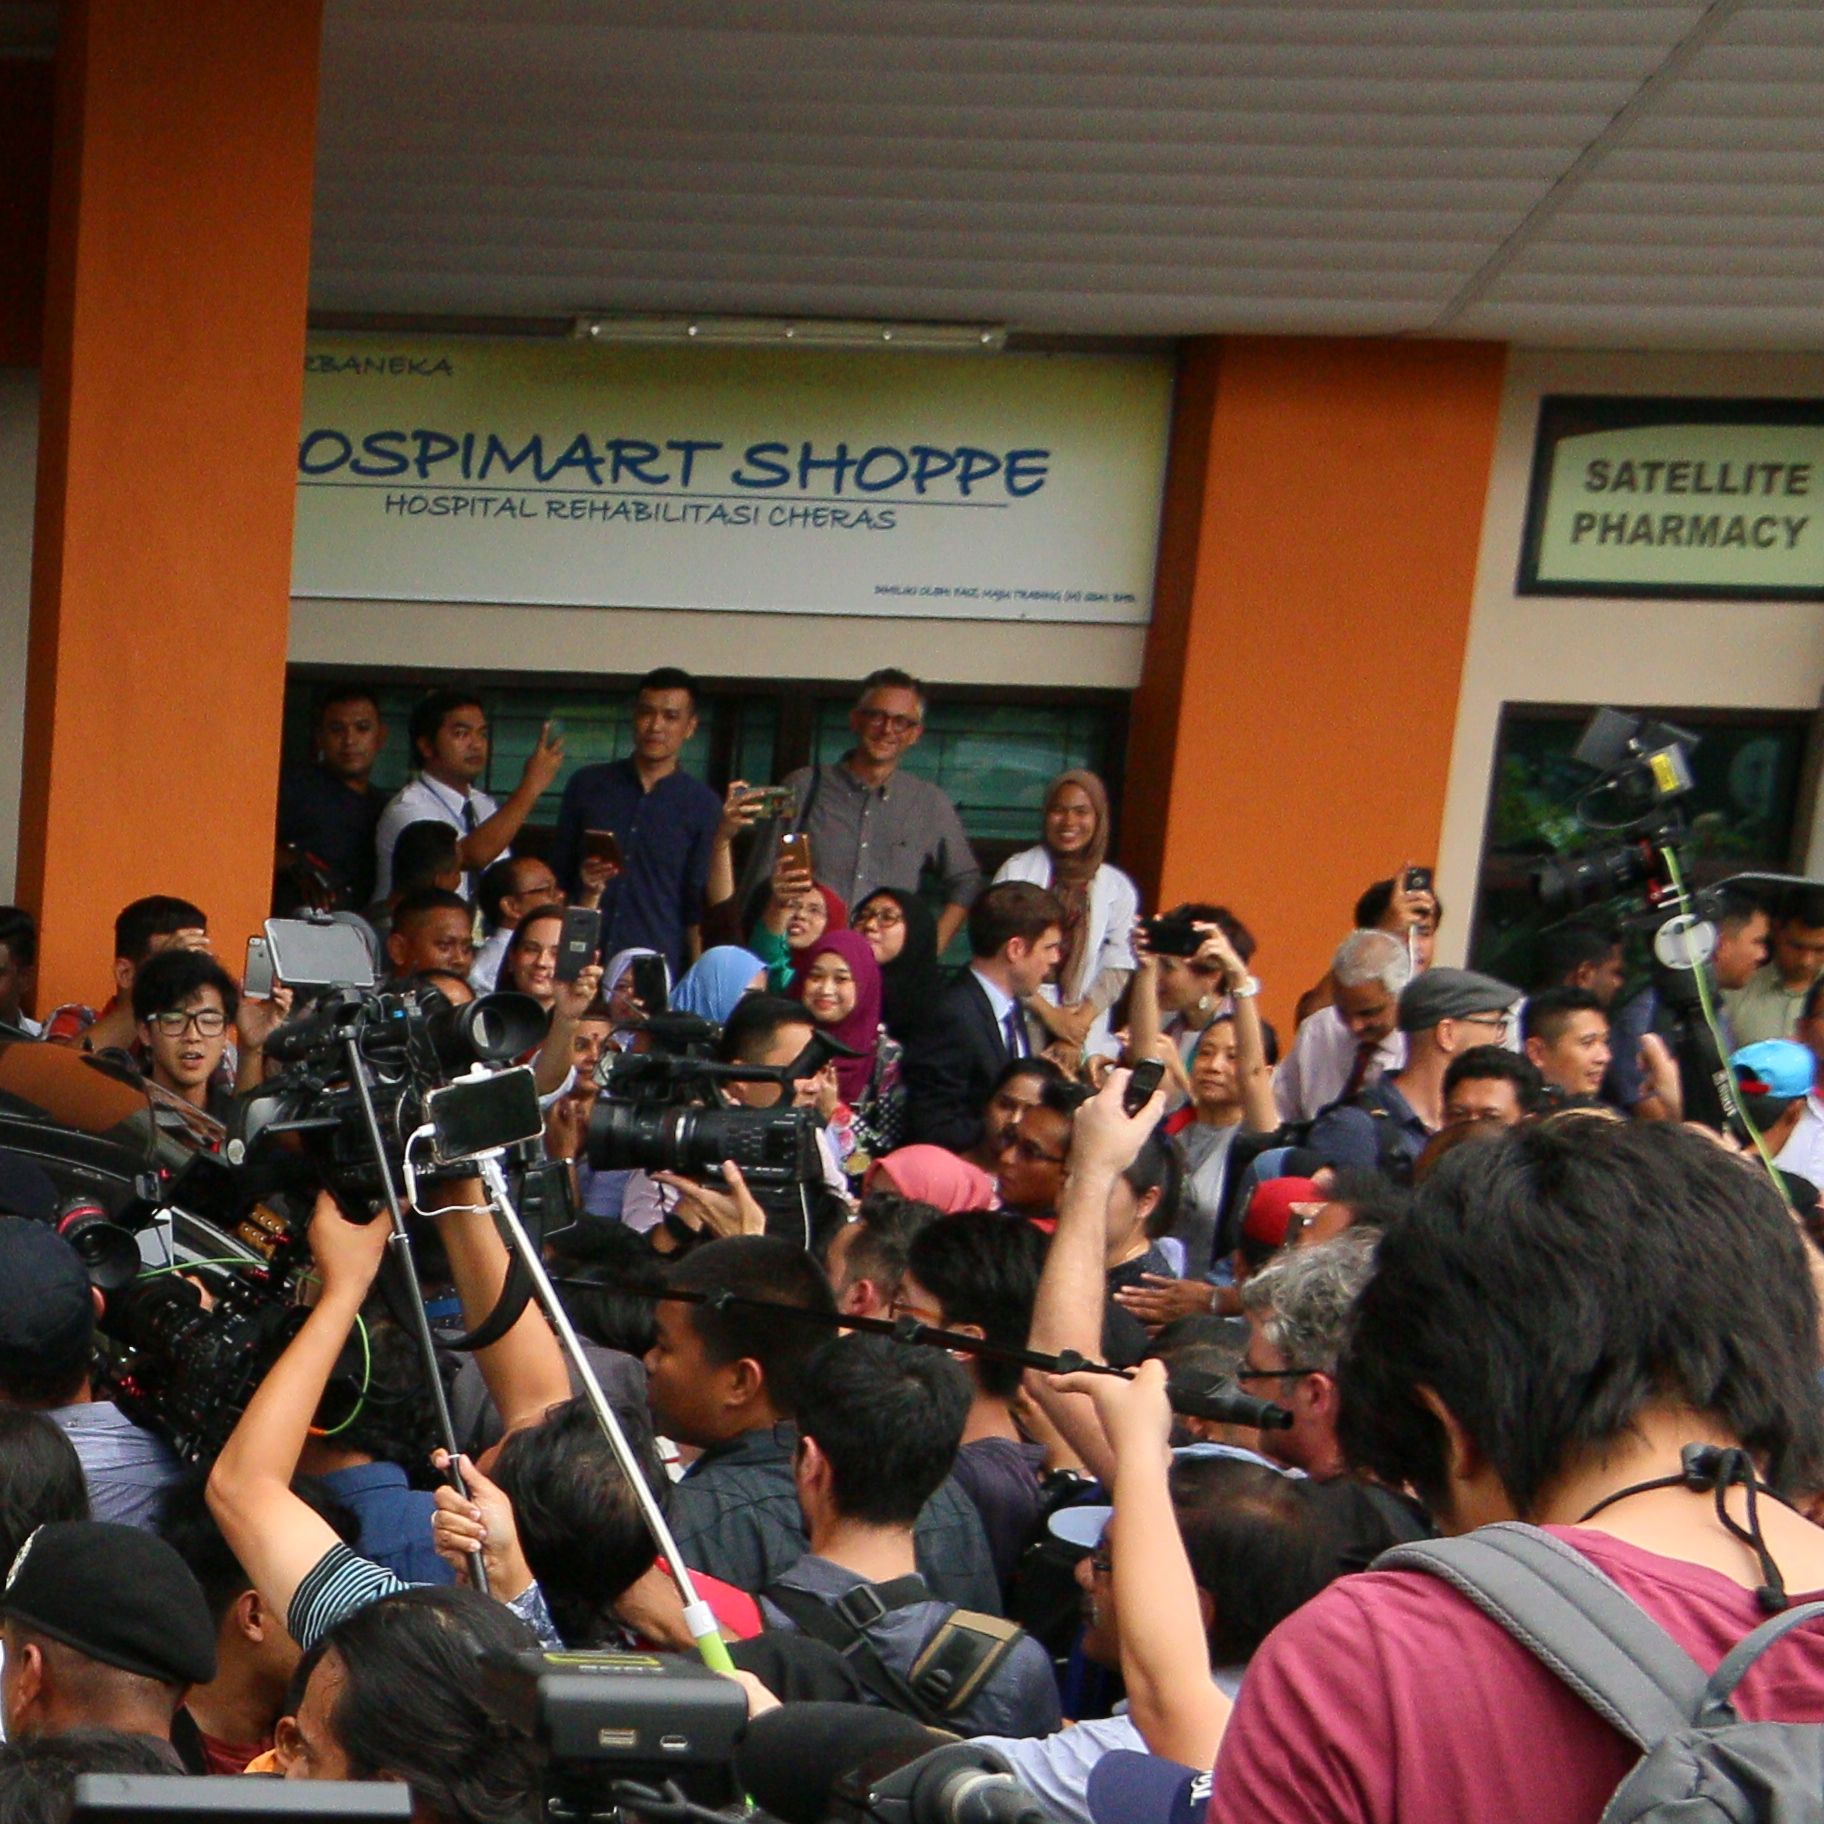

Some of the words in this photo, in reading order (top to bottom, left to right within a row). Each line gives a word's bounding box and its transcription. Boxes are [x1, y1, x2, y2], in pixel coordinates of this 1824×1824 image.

[298, 429, 723, 487] OSPIMART
[730, 441, 1051, 497] SHOPPE
[1585, 458, 1811, 495] SATELLITE
[385, 493, 539, 519] HOSPITAL
[546, 499, 759, 526] REHABILITASI
[768, 504, 897, 529] CHERAS
[1570, 511, 1809, 549] PHARMACY
